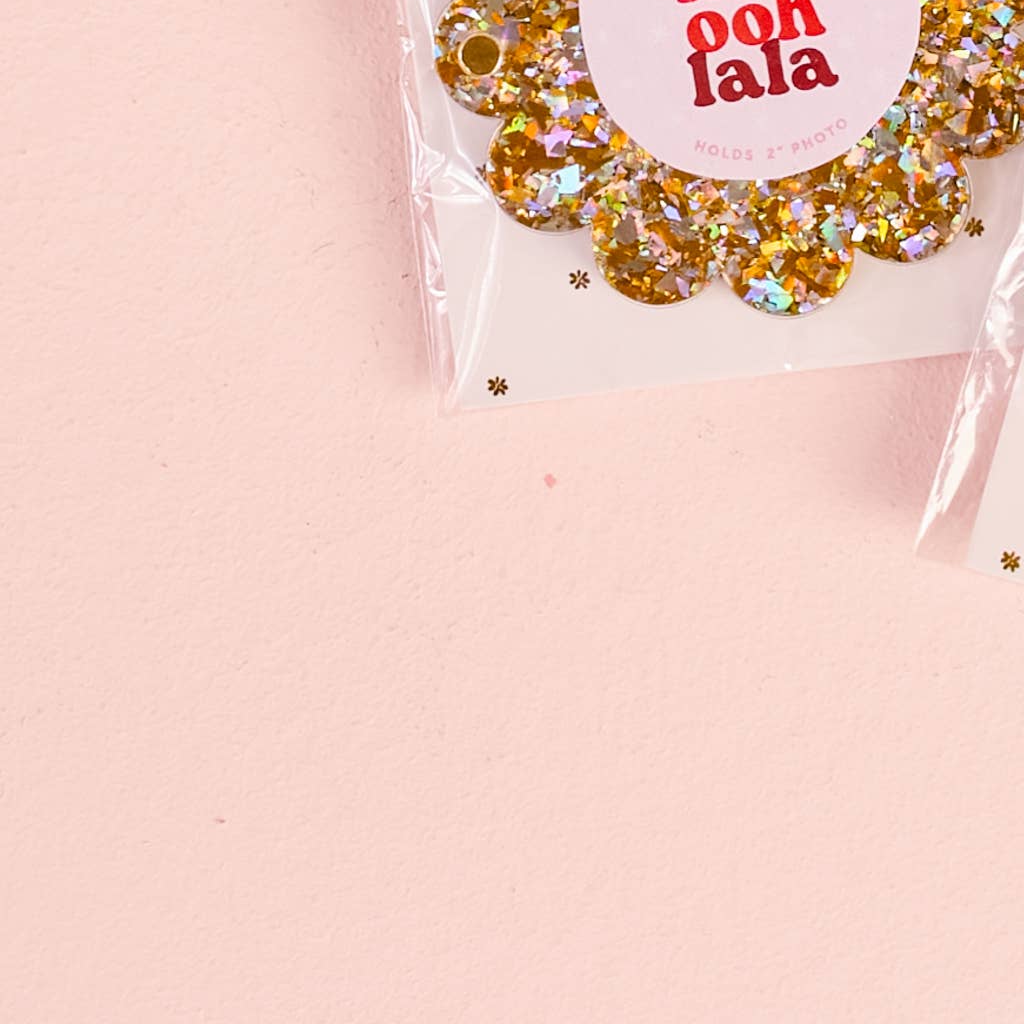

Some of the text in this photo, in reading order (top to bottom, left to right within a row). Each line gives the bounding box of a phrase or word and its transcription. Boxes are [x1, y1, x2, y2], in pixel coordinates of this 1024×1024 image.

[686, 37, 840, 108] lala
[693, 139, 754, 162] HOLDS
[791, 117, 849, 155] PHOTO
